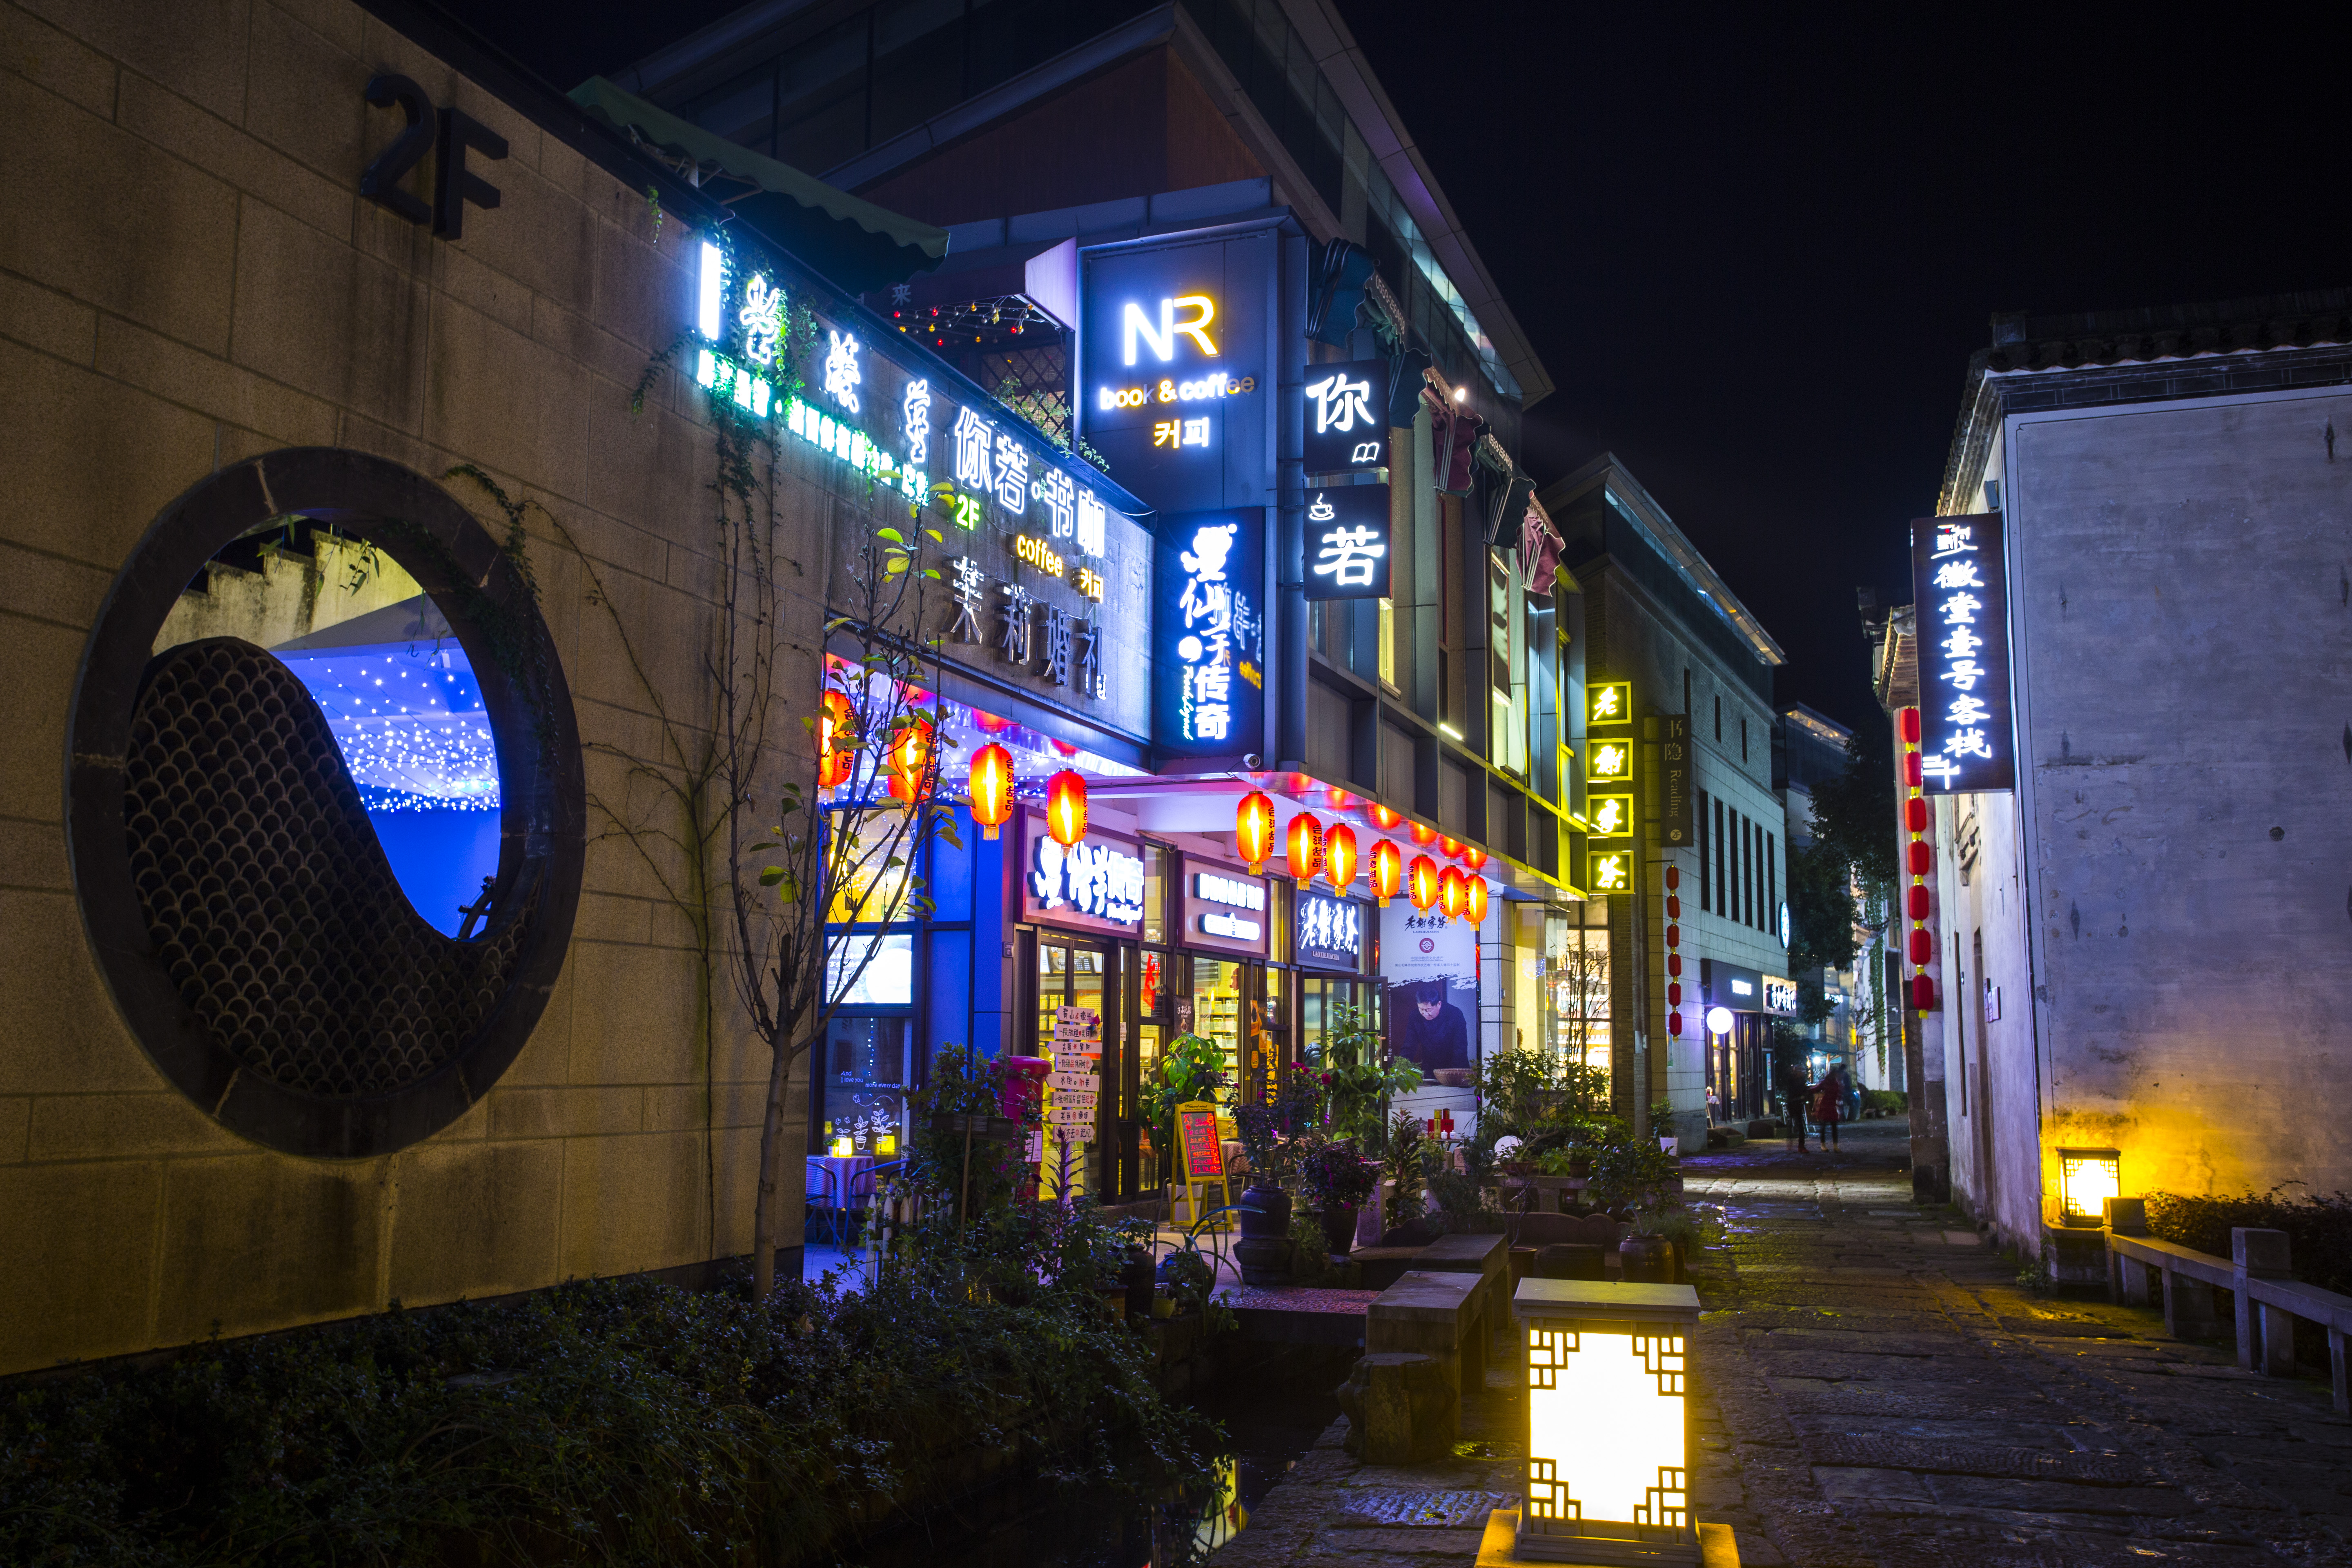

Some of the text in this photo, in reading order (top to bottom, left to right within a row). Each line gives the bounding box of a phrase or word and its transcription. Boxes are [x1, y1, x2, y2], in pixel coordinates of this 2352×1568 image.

[360, 74, 509, 242] 2F
[1124, 295, 1218, 366] NR
[1100, 373, 1255, 410] book & coffee
[1305, 373, 1374, 434] 你
[1154, 417, 1209, 449] 커피
[956, 493, 981, 531] 2F
[1017, 534, 1063, 577] coffee
[1314, 525, 1385, 586] 若
[1080, 567, 1104, 604] 커피
[1665, 719, 1683, 762] 书隐
[1668, 769, 1682, 817] Reading
[1312, 950, 1340, 961] LAOXIEJIACHA
